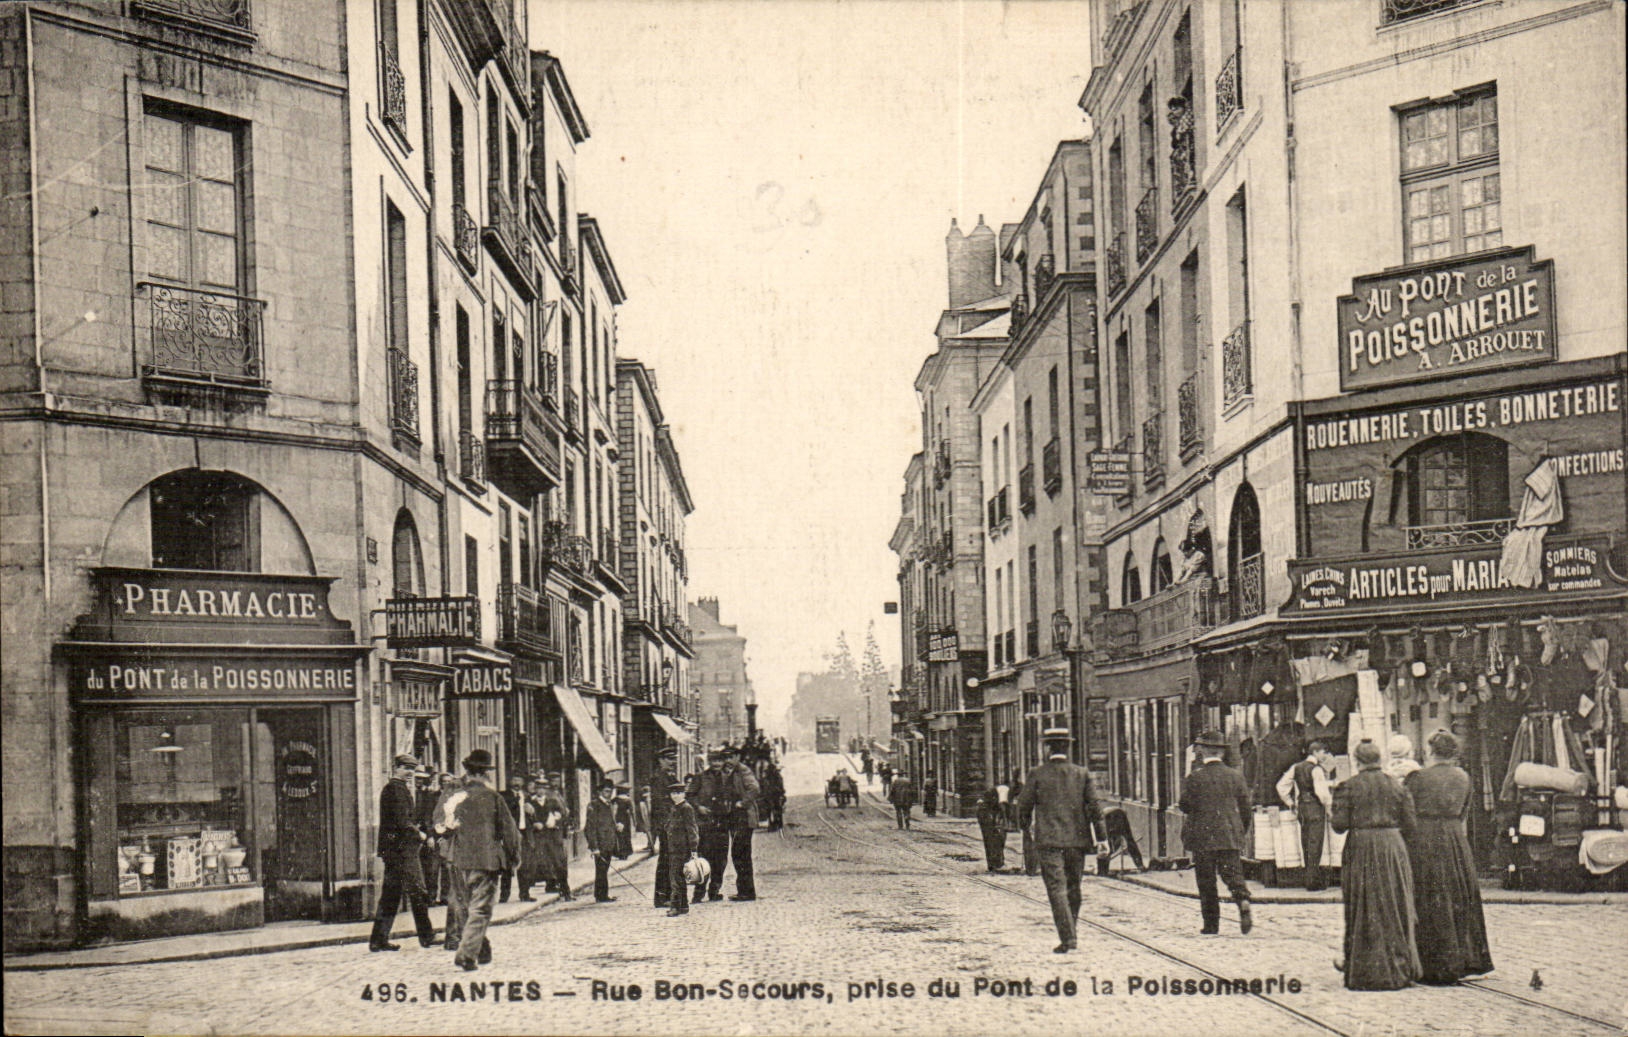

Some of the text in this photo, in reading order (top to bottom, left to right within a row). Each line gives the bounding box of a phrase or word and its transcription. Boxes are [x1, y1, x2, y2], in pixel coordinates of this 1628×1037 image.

[1477, 270, 1498, 288] de
[1501, 264, 1517, 284] la
[1349, 278, 1540, 372] POISSONNERIE
[1449, 330, 1546, 366] ARROUET
[1500, 382, 1619, 426] BONNETERIE
[1551, 448, 1625, 477] ONFECTIONS
[1306, 476, 1371, 505] NOUVEAUTÉS
[1349, 565, 1429, 599] ARTICLES
[1430, 575, 1451, 599] pour
[123, 583, 317, 618] PHARMACIE
[387, 600, 475, 638] PHARMACIE
[87, 665, 354, 691] du PONT de la POISSONNERIE
